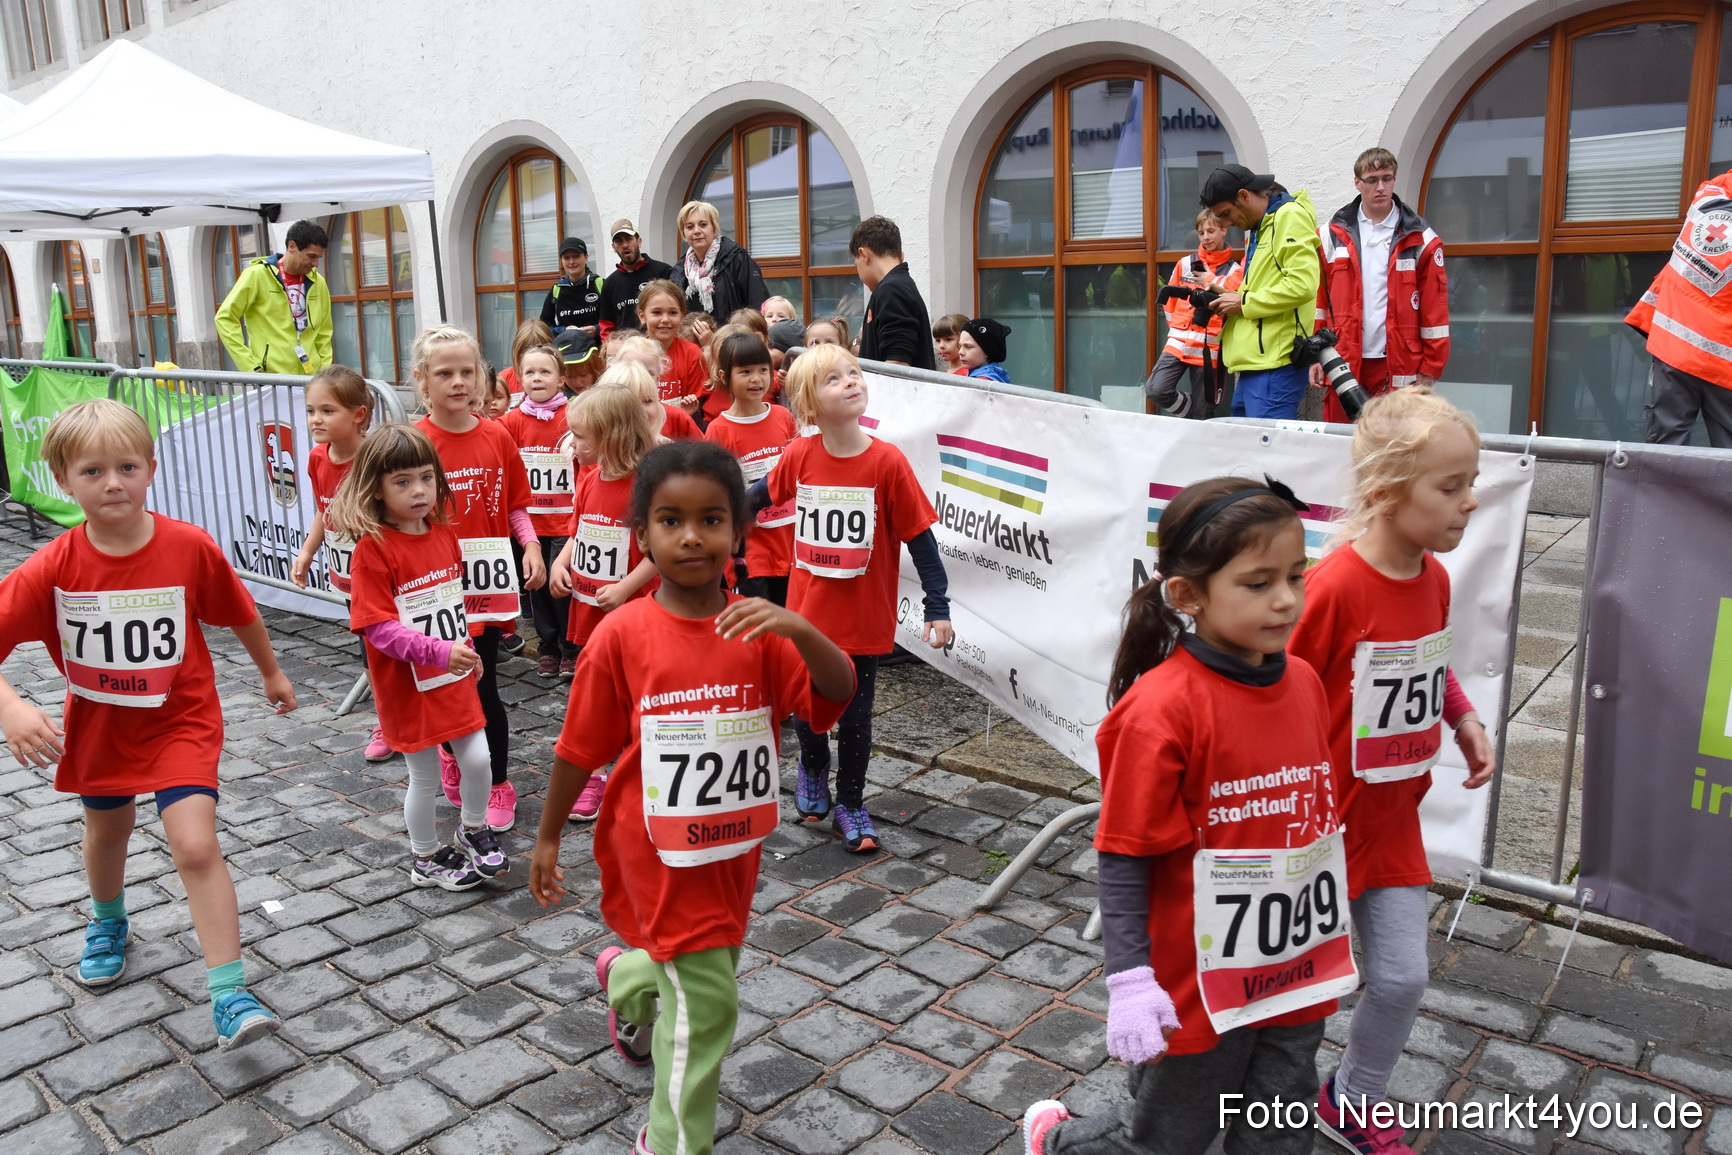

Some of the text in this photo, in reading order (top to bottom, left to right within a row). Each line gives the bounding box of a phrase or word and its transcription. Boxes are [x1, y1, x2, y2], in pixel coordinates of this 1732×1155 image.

[1695, 223, 1730, 253] ROTES KREUZ
[1674, 240, 1719, 279] Sanitätsdienst
[445, 467, 484, 480] markter
[526, 468, 569, 491] 014
[818, 489, 867, 502] BOCK
[584, 525, 622, 540] BOCK
[797, 505, 866, 544] 7109
[935, 491, 1053, 565] NeuerMarkt
[463, 540, 506, 552] BOCK
[573, 537, 617, 577] 7031
[809, 549, 841, 566] Laura
[936, 537, 1047, 593] inkaufen leben genießen
[397, 568, 448, 595] Neumarkter
[441, 581, 463, 599] BO
[109, 592, 176, 610] BOCK
[65, 617, 177, 663] 7103
[1423, 631, 1452, 658] BOC
[971, 644, 986, 665] 500
[1369, 656, 1417, 667] NeuerMarkt
[98, 673, 148, 692] Paula
[639, 684, 738, 712] Neumarkter
[1373, 665, 1448, 729] 750
[716, 714, 769, 737] BOCK
[1022, 693, 1085, 742] NM-Neumarkt
[654, 732, 707, 741] NeuerMarkt
[660, 745, 771, 807] 7248
[1210, 764, 1311, 801] Neumarkter
[1207, 791, 1298, 827] Stadtlauf
[687, 815, 752, 846] Shamat
[1210, 870, 1274, 880] NeuerMarkt
[1215, 870, 1339, 958] 7099
[1242, 958, 1315, 1001] Victoria
